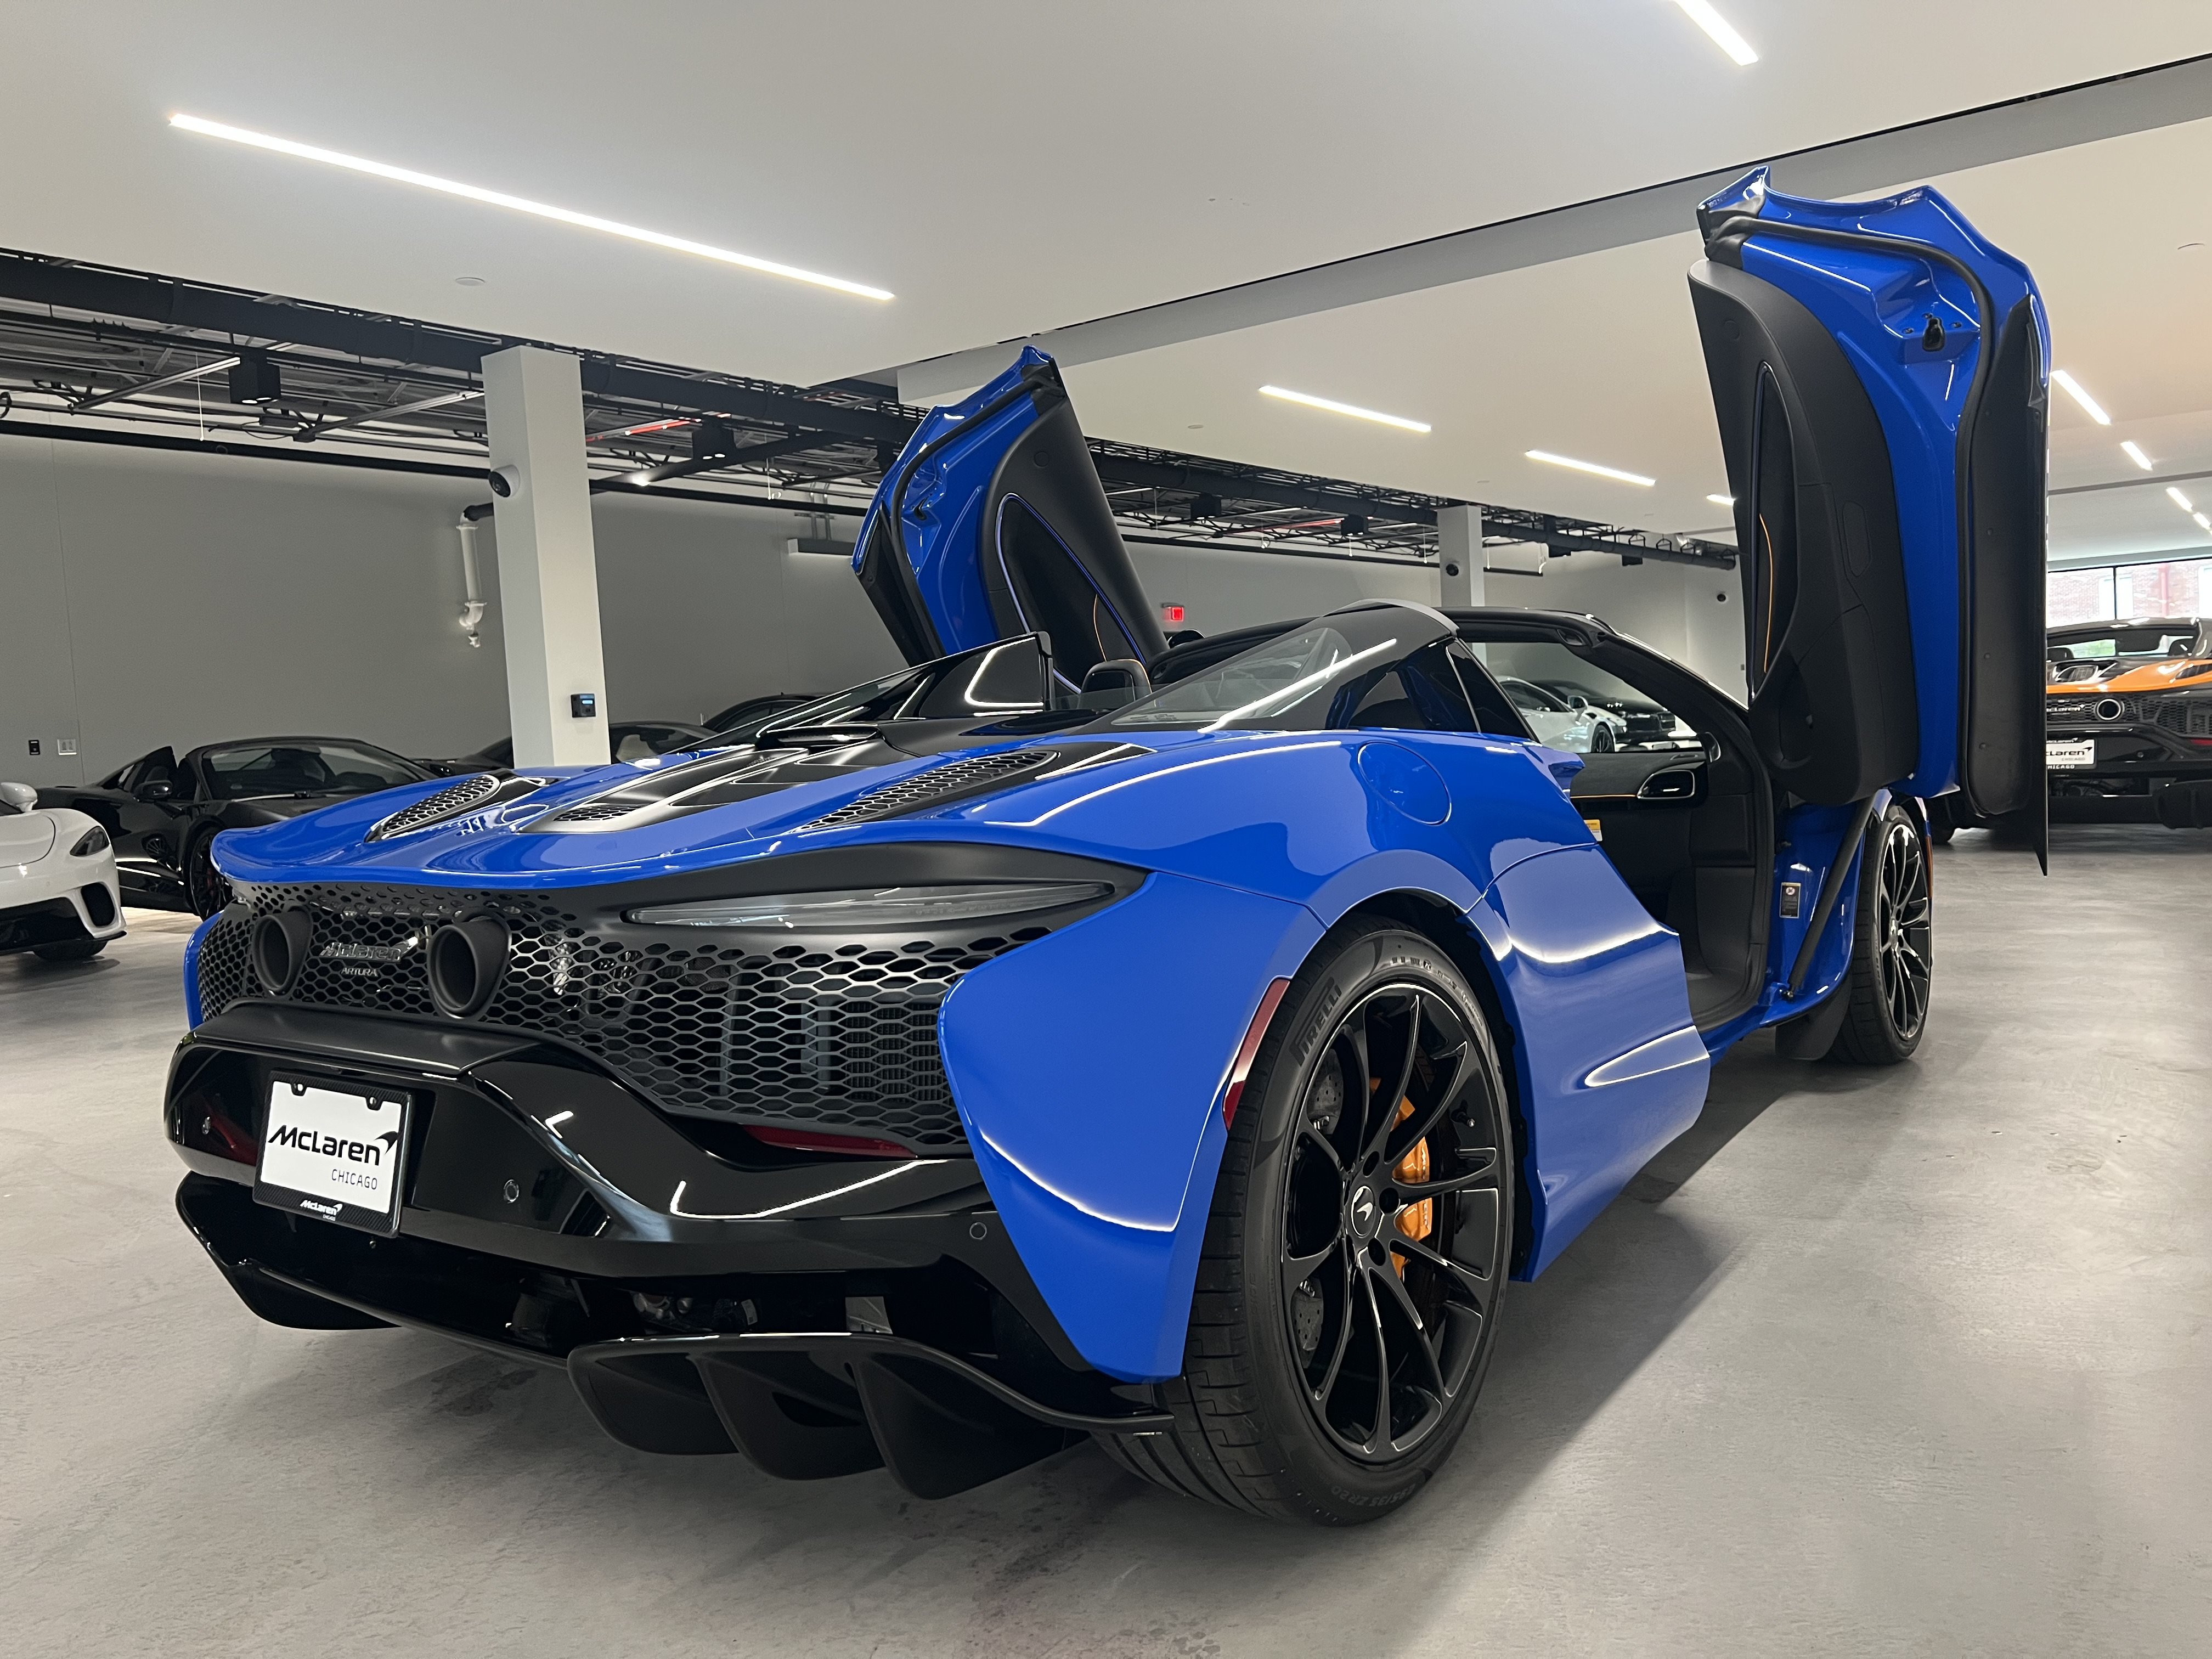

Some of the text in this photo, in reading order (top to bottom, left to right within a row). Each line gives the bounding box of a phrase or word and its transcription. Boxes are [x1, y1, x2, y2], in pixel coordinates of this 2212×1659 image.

[319, 941, 402, 962] McLaren
[341, 967, 379, 977] ARTURA
[1289, 977, 1342, 1067] PIRELLI
[268, 1124, 380, 1166] McLaren
[331, 1169, 378, 1190] CHICAGO
[300, 1199, 337, 1216] McLaren
